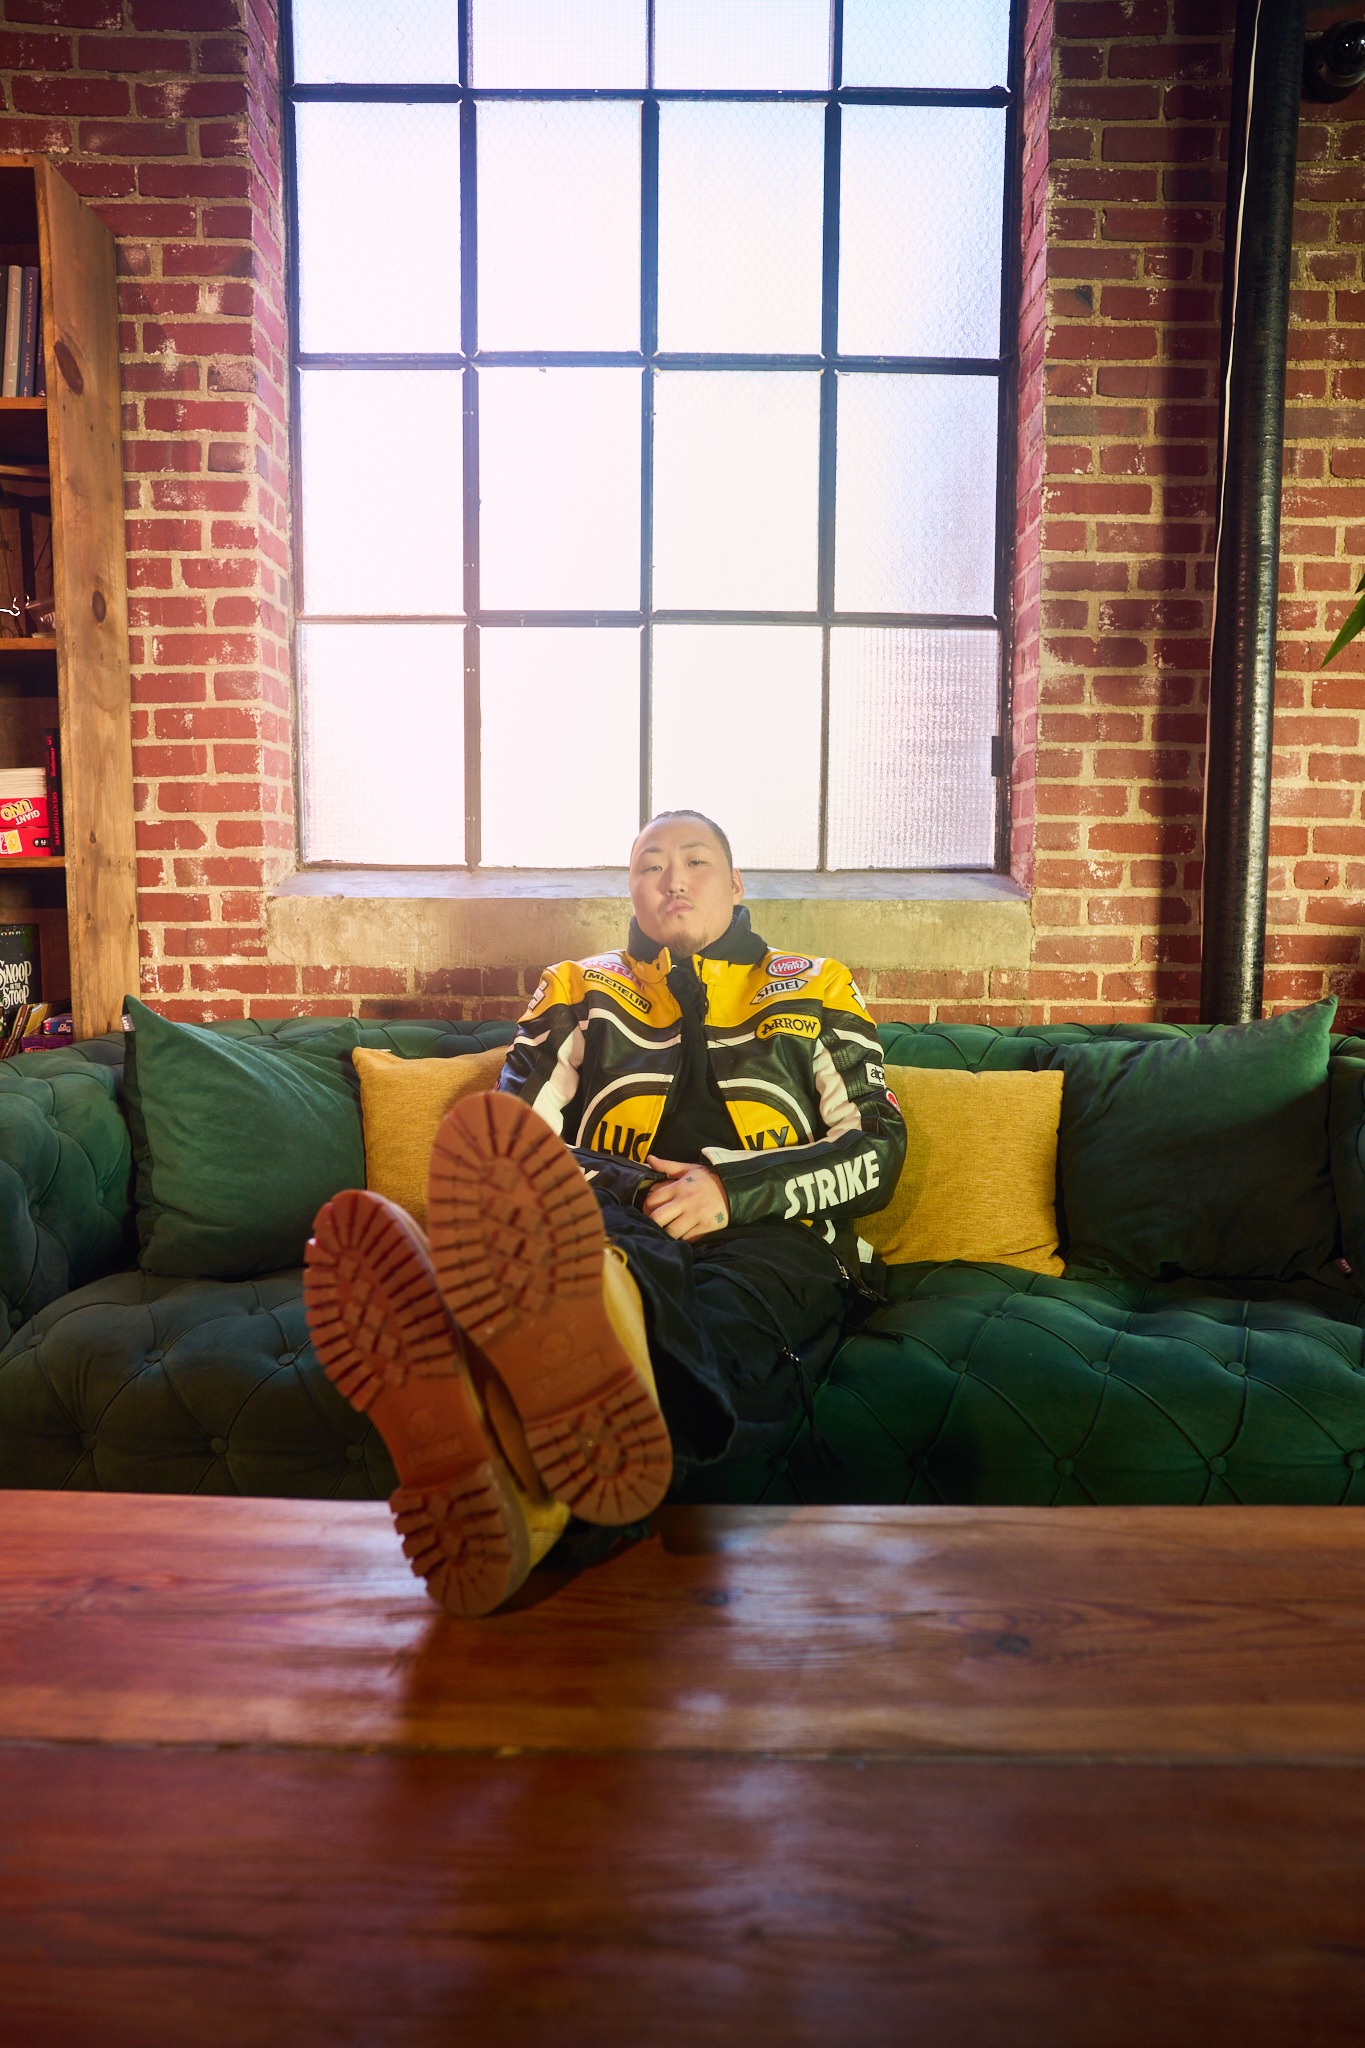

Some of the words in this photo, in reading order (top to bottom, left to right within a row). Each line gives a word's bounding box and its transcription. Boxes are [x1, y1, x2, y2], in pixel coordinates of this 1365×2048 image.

[1, 798, 33, 821] UNO
[16, 809, 40, 826] GIANT
[772, 960, 805, 969] LUCKY
[773, 963, 807, 973] STRIKE
[2, 984, 30, 1010] STOOP
[588, 972, 648, 1010] MICHELIN
[757, 980, 799, 1001] SHOEI
[761, 1018, 817, 1035] ARROW
[784, 1150, 880, 1220] STRIKE
